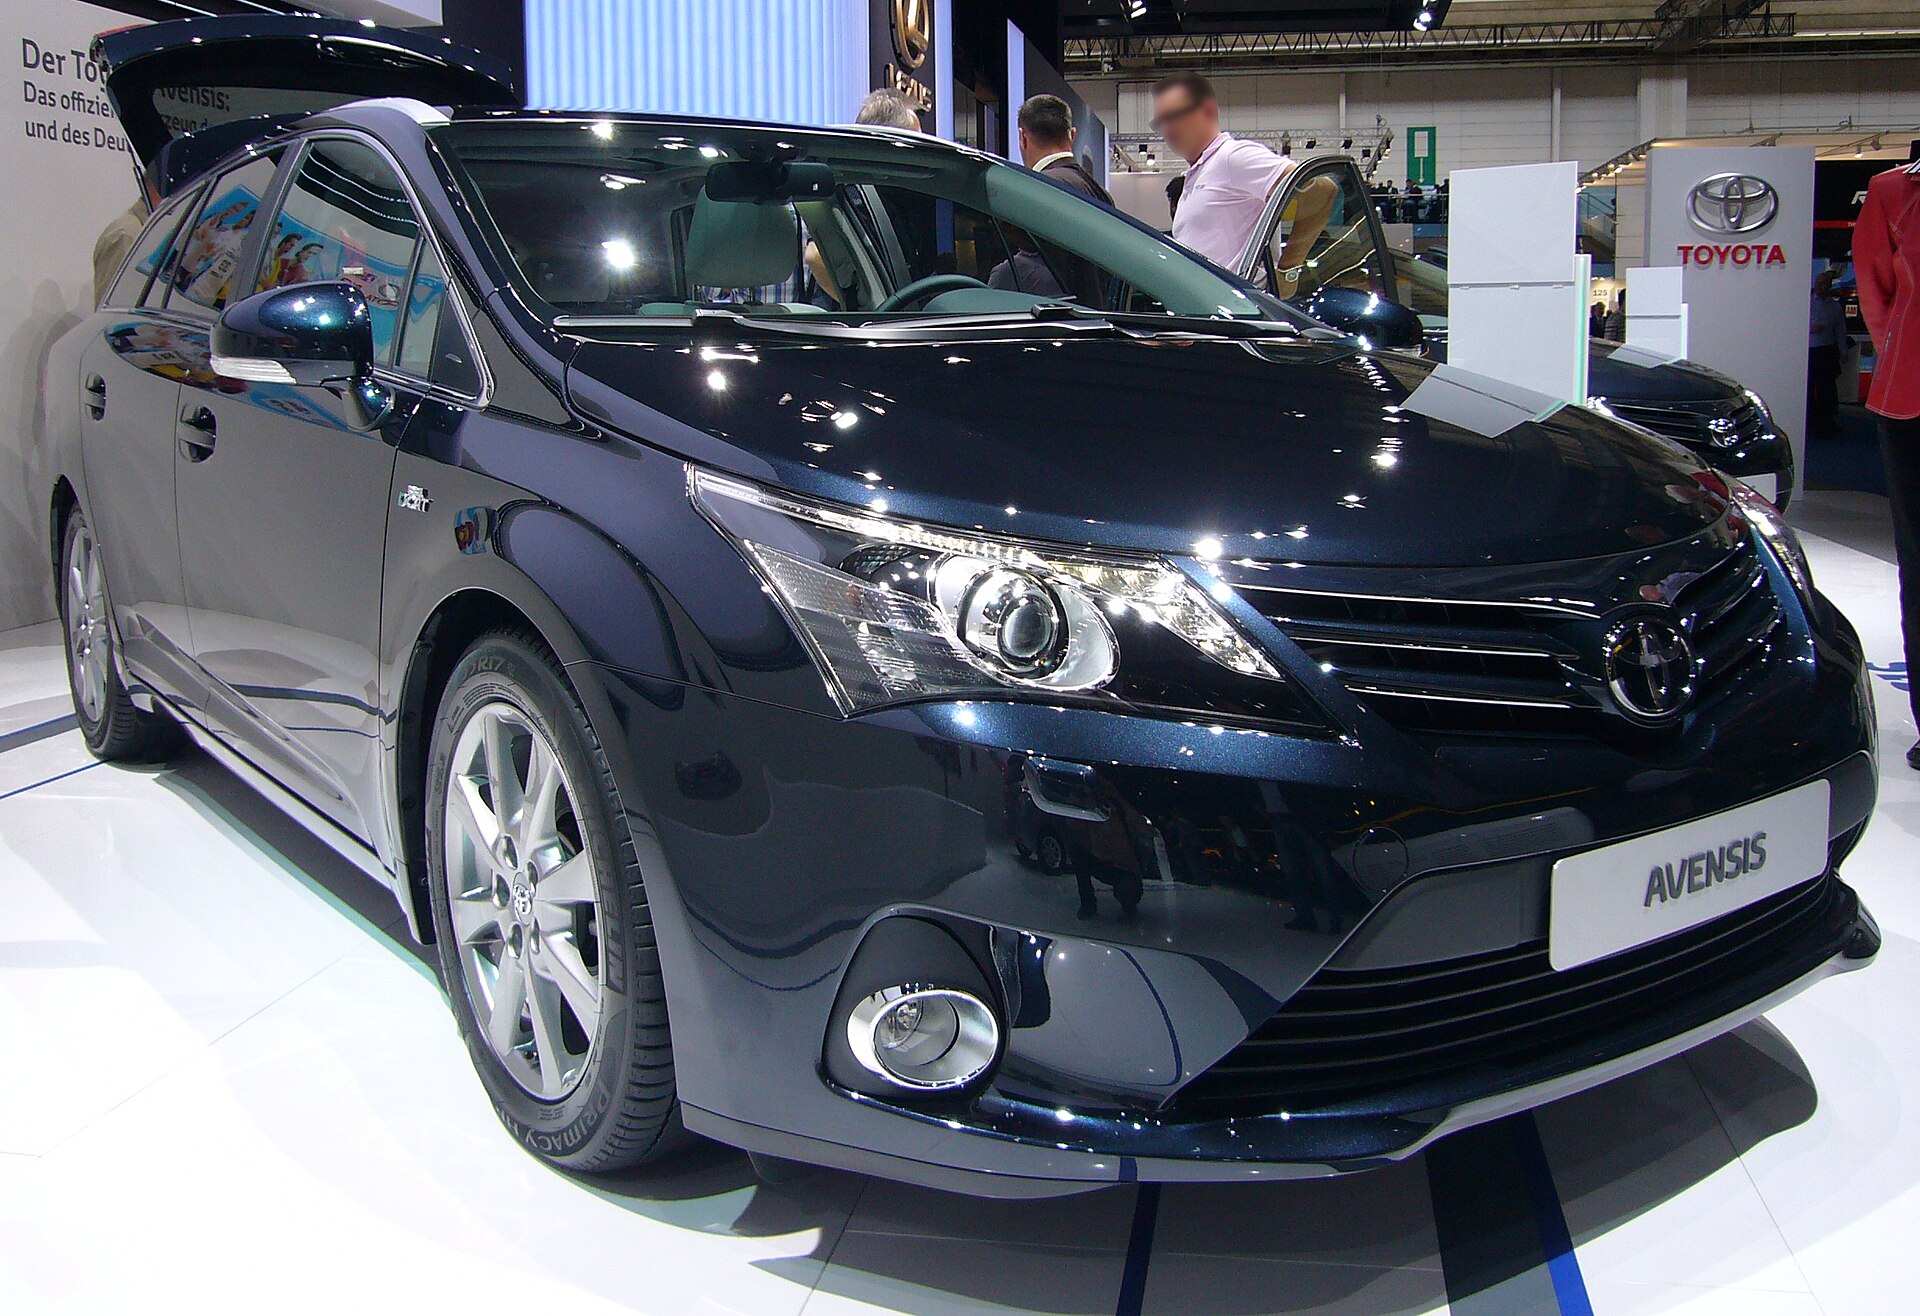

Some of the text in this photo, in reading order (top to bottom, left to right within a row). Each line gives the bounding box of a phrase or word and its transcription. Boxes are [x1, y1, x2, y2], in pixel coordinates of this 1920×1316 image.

[21, 37, 67, 75] Der
[23, 80, 56, 106] Das
[25, 119, 57, 141] und
[62, 122, 90, 146] des
[1677, 244, 1786, 266] TOYOTA
[1643, 831, 1768, 908] AVENSIS
